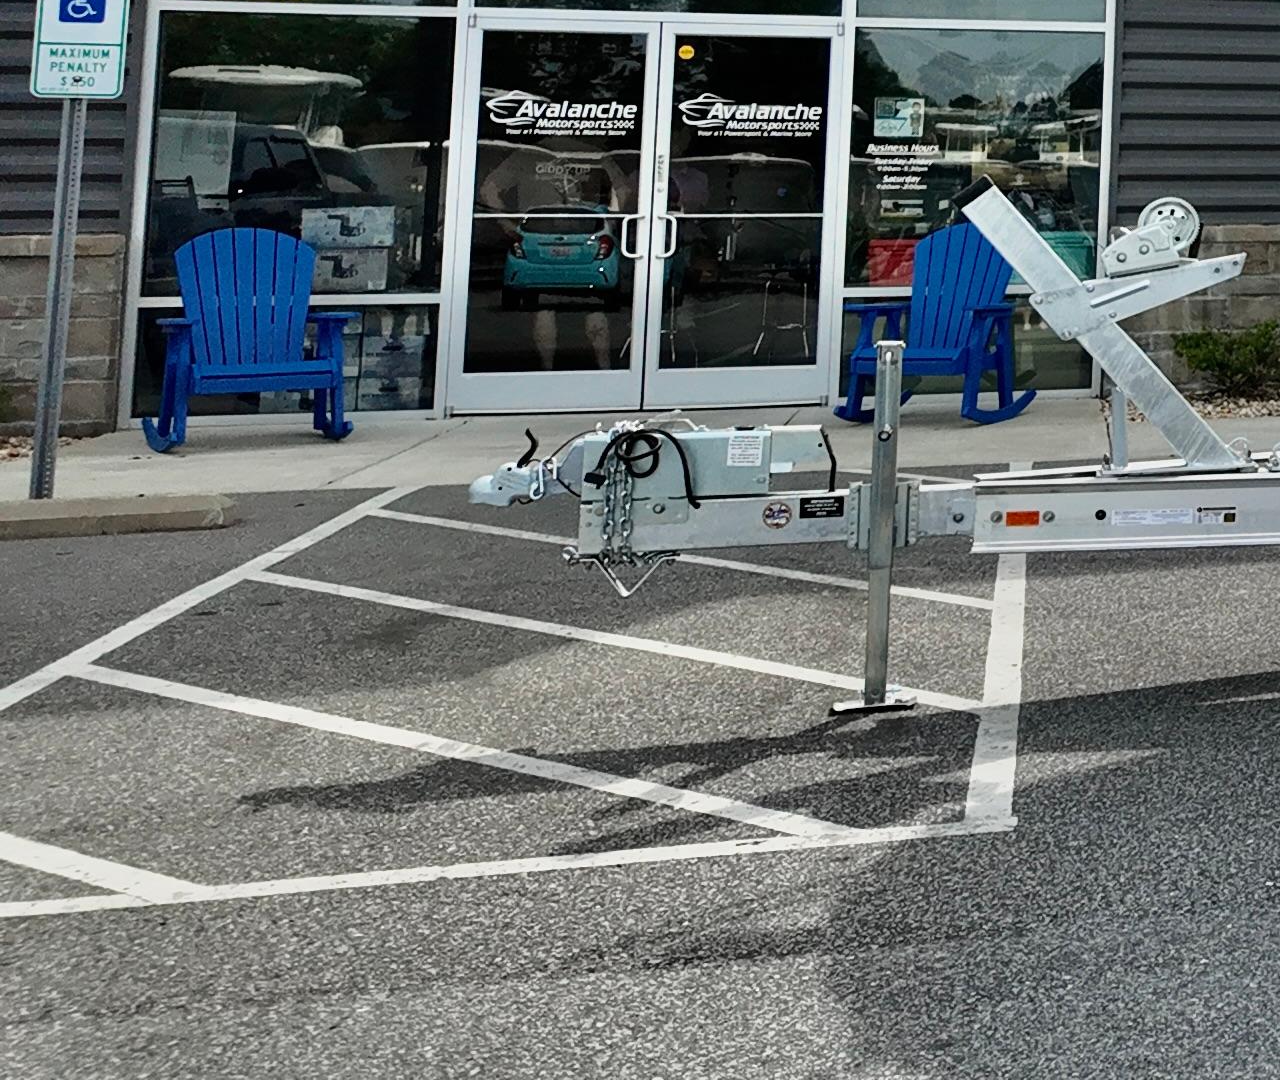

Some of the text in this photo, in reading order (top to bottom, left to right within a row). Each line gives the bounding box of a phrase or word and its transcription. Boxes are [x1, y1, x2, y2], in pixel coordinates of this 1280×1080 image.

[49, 48, 110, 59] MAXIMUM
[49, 61, 107, 73] PENALTY
[515, 99, 638, 119] Avalanche
[706, 103, 823, 120] Avalanche
[536, 119, 614, 129] Motorsports
[726, 120, 800, 131] Motorsports
[866, 143, 940, 153] Business Hours
[882, 175, 922, 183] Saturday
